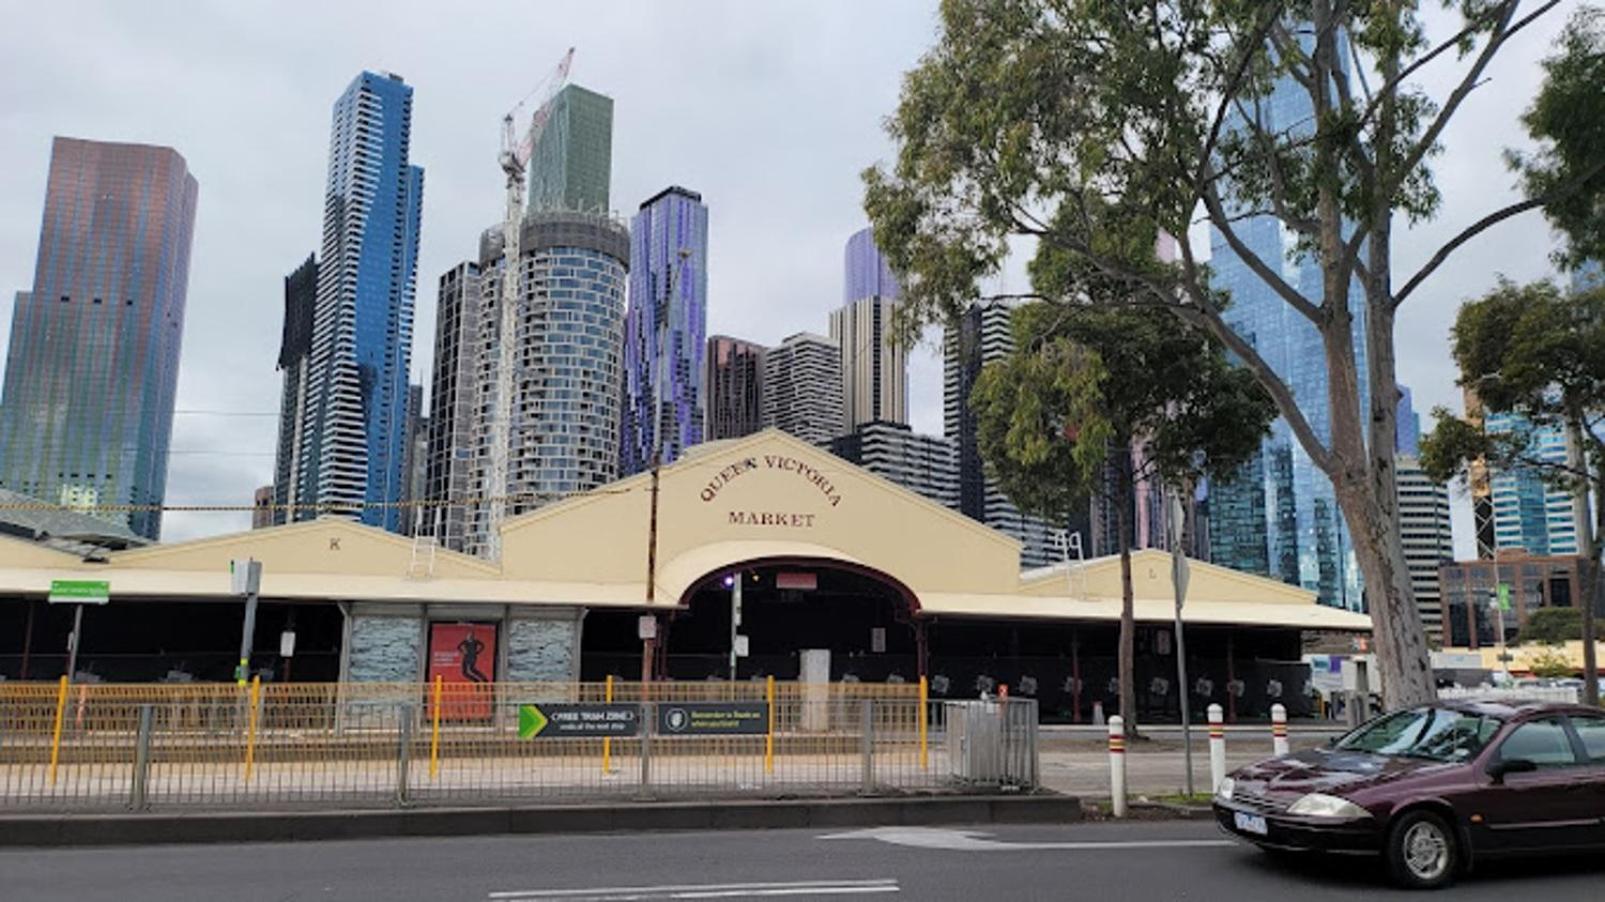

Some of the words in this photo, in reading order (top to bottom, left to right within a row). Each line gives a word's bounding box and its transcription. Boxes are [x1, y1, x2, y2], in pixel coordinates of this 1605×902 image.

[763, 455, 842, 507] VICTORIA
[728, 511, 816, 527] MARKET
[329, 537, 341, 551] K
